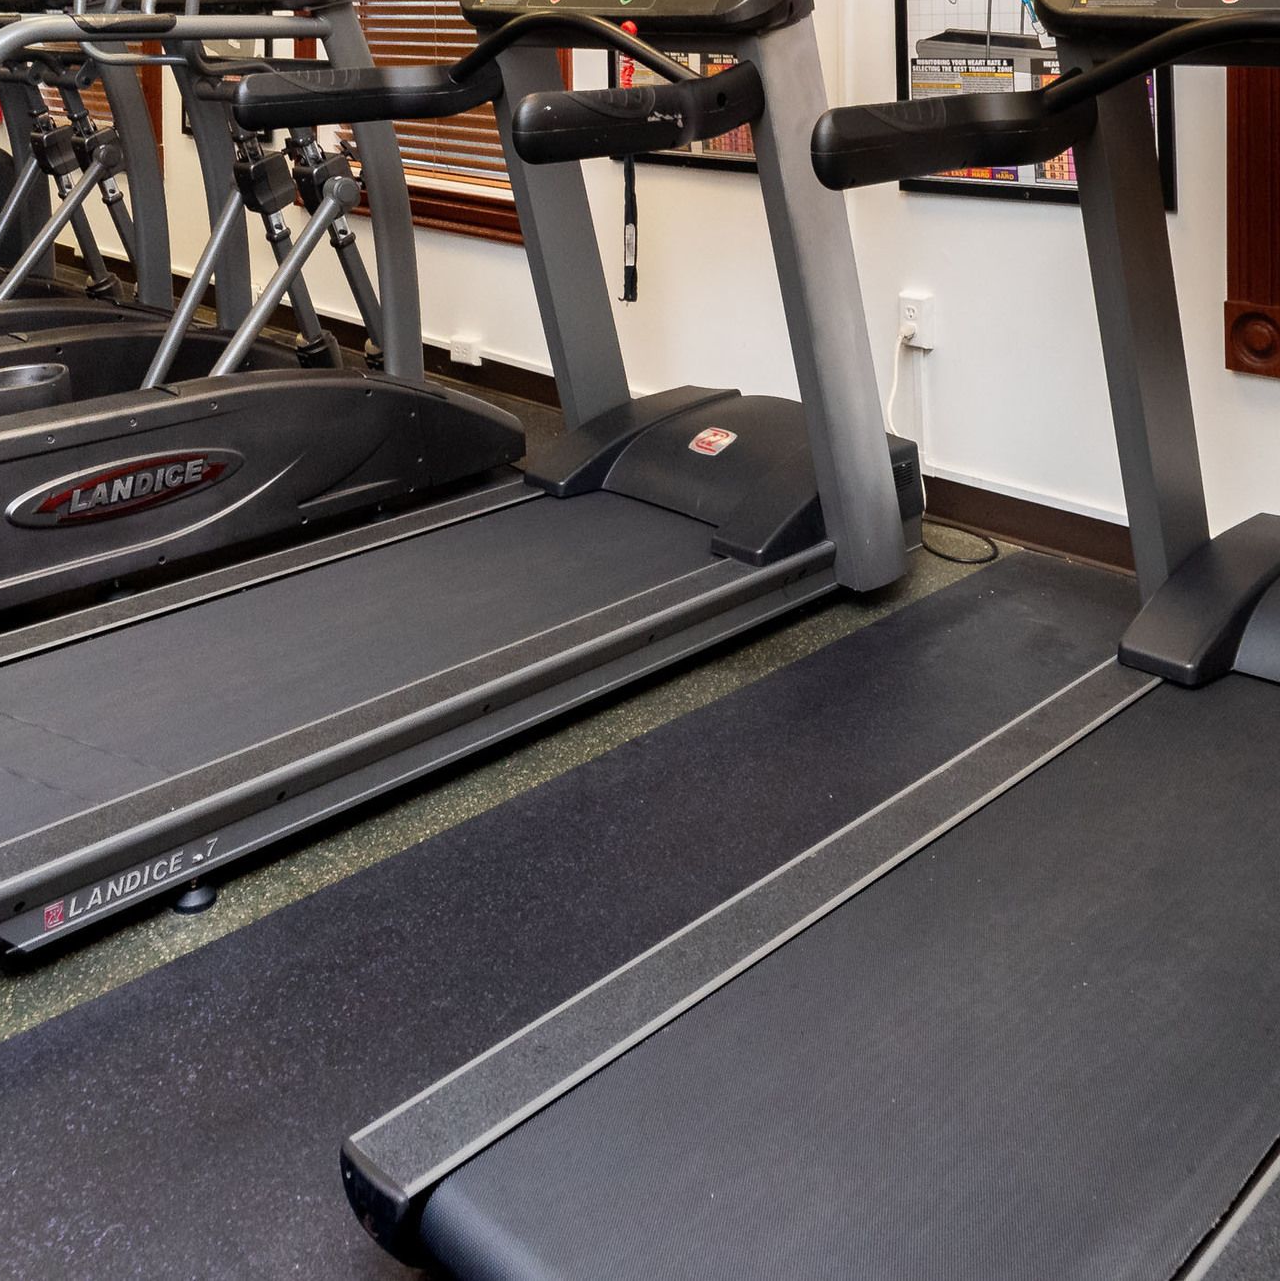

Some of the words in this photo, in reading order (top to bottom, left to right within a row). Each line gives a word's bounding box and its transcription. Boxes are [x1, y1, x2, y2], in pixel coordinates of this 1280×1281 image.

[912, 65, 941, 73] SELECTING
[942, 65, 952, 73] THE
[953, 65, 968, 73] BEST
[971, 172, 991, 180] HARD
[995, 172, 1015, 181] HARD
[70, 459, 204, 513] LANDICE
[69, 849, 184, 918] LANDICE
